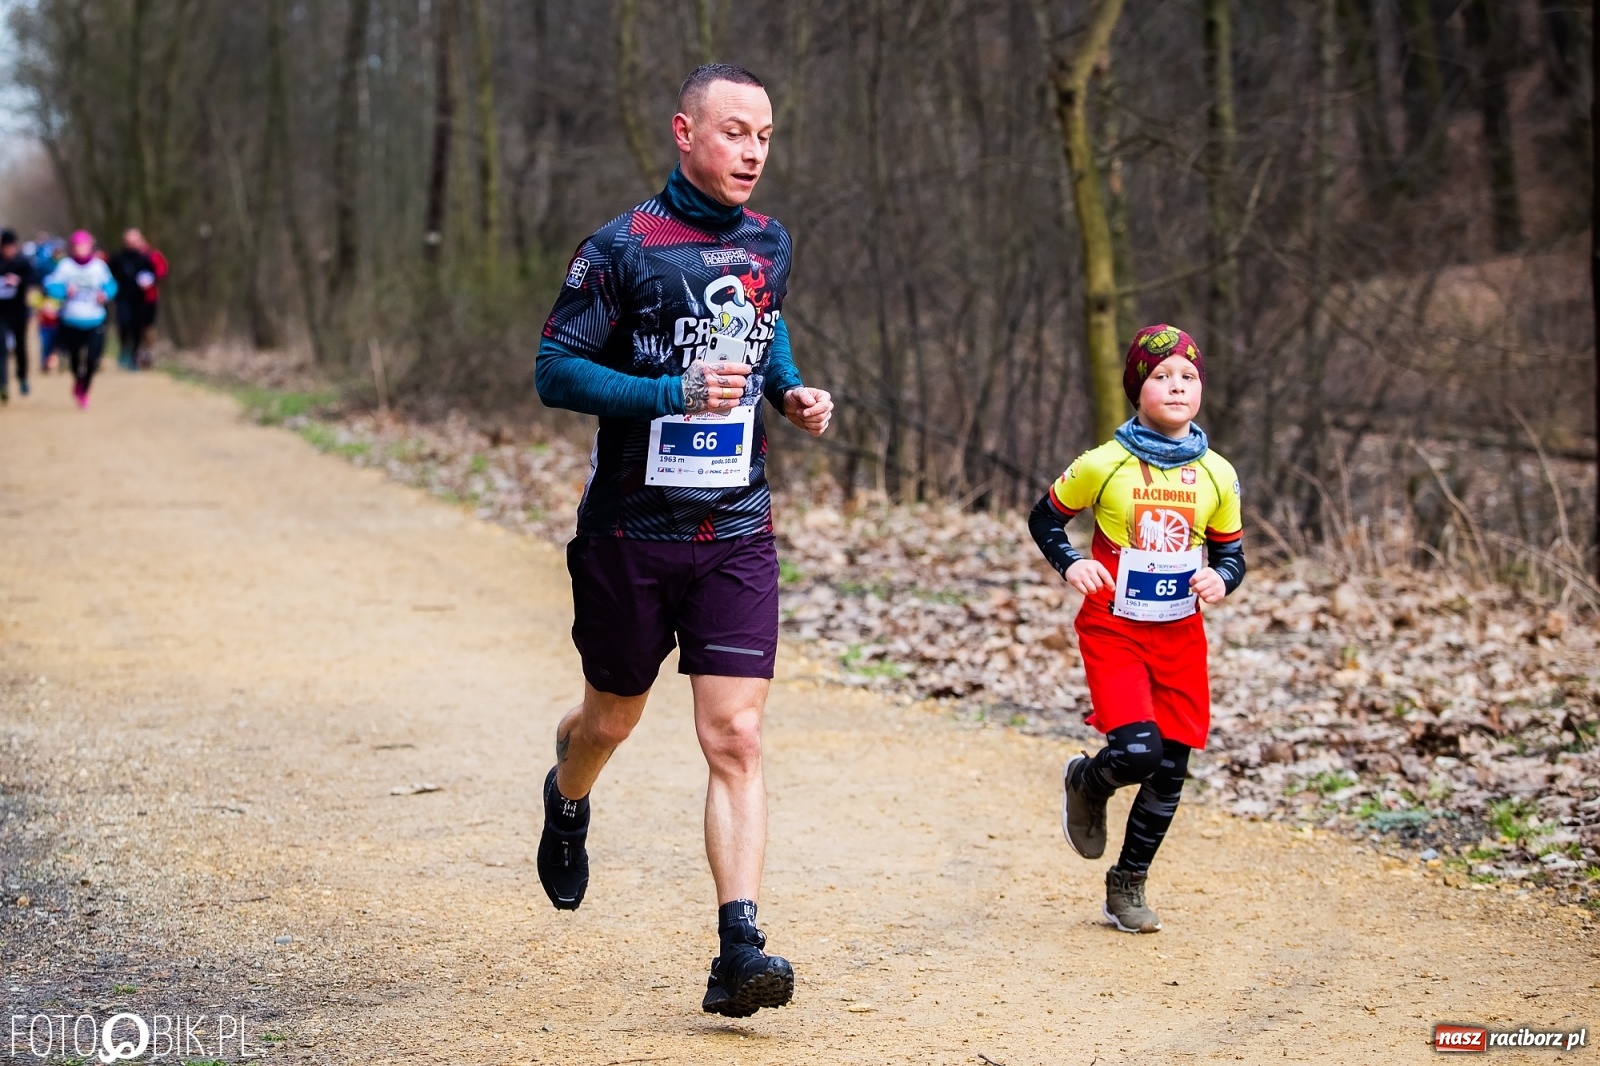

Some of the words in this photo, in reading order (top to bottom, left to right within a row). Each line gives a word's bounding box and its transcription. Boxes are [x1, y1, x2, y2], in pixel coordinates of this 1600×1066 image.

[703, 250, 744, 260] EXTREME
[692, 432, 717, 450] 66
[660, 455, 676, 463] 1963
[1133, 488, 1197, 503] RACIBORKI
[1155, 580, 1177, 596] 65
[1126, 599, 1140, 607] 1963
